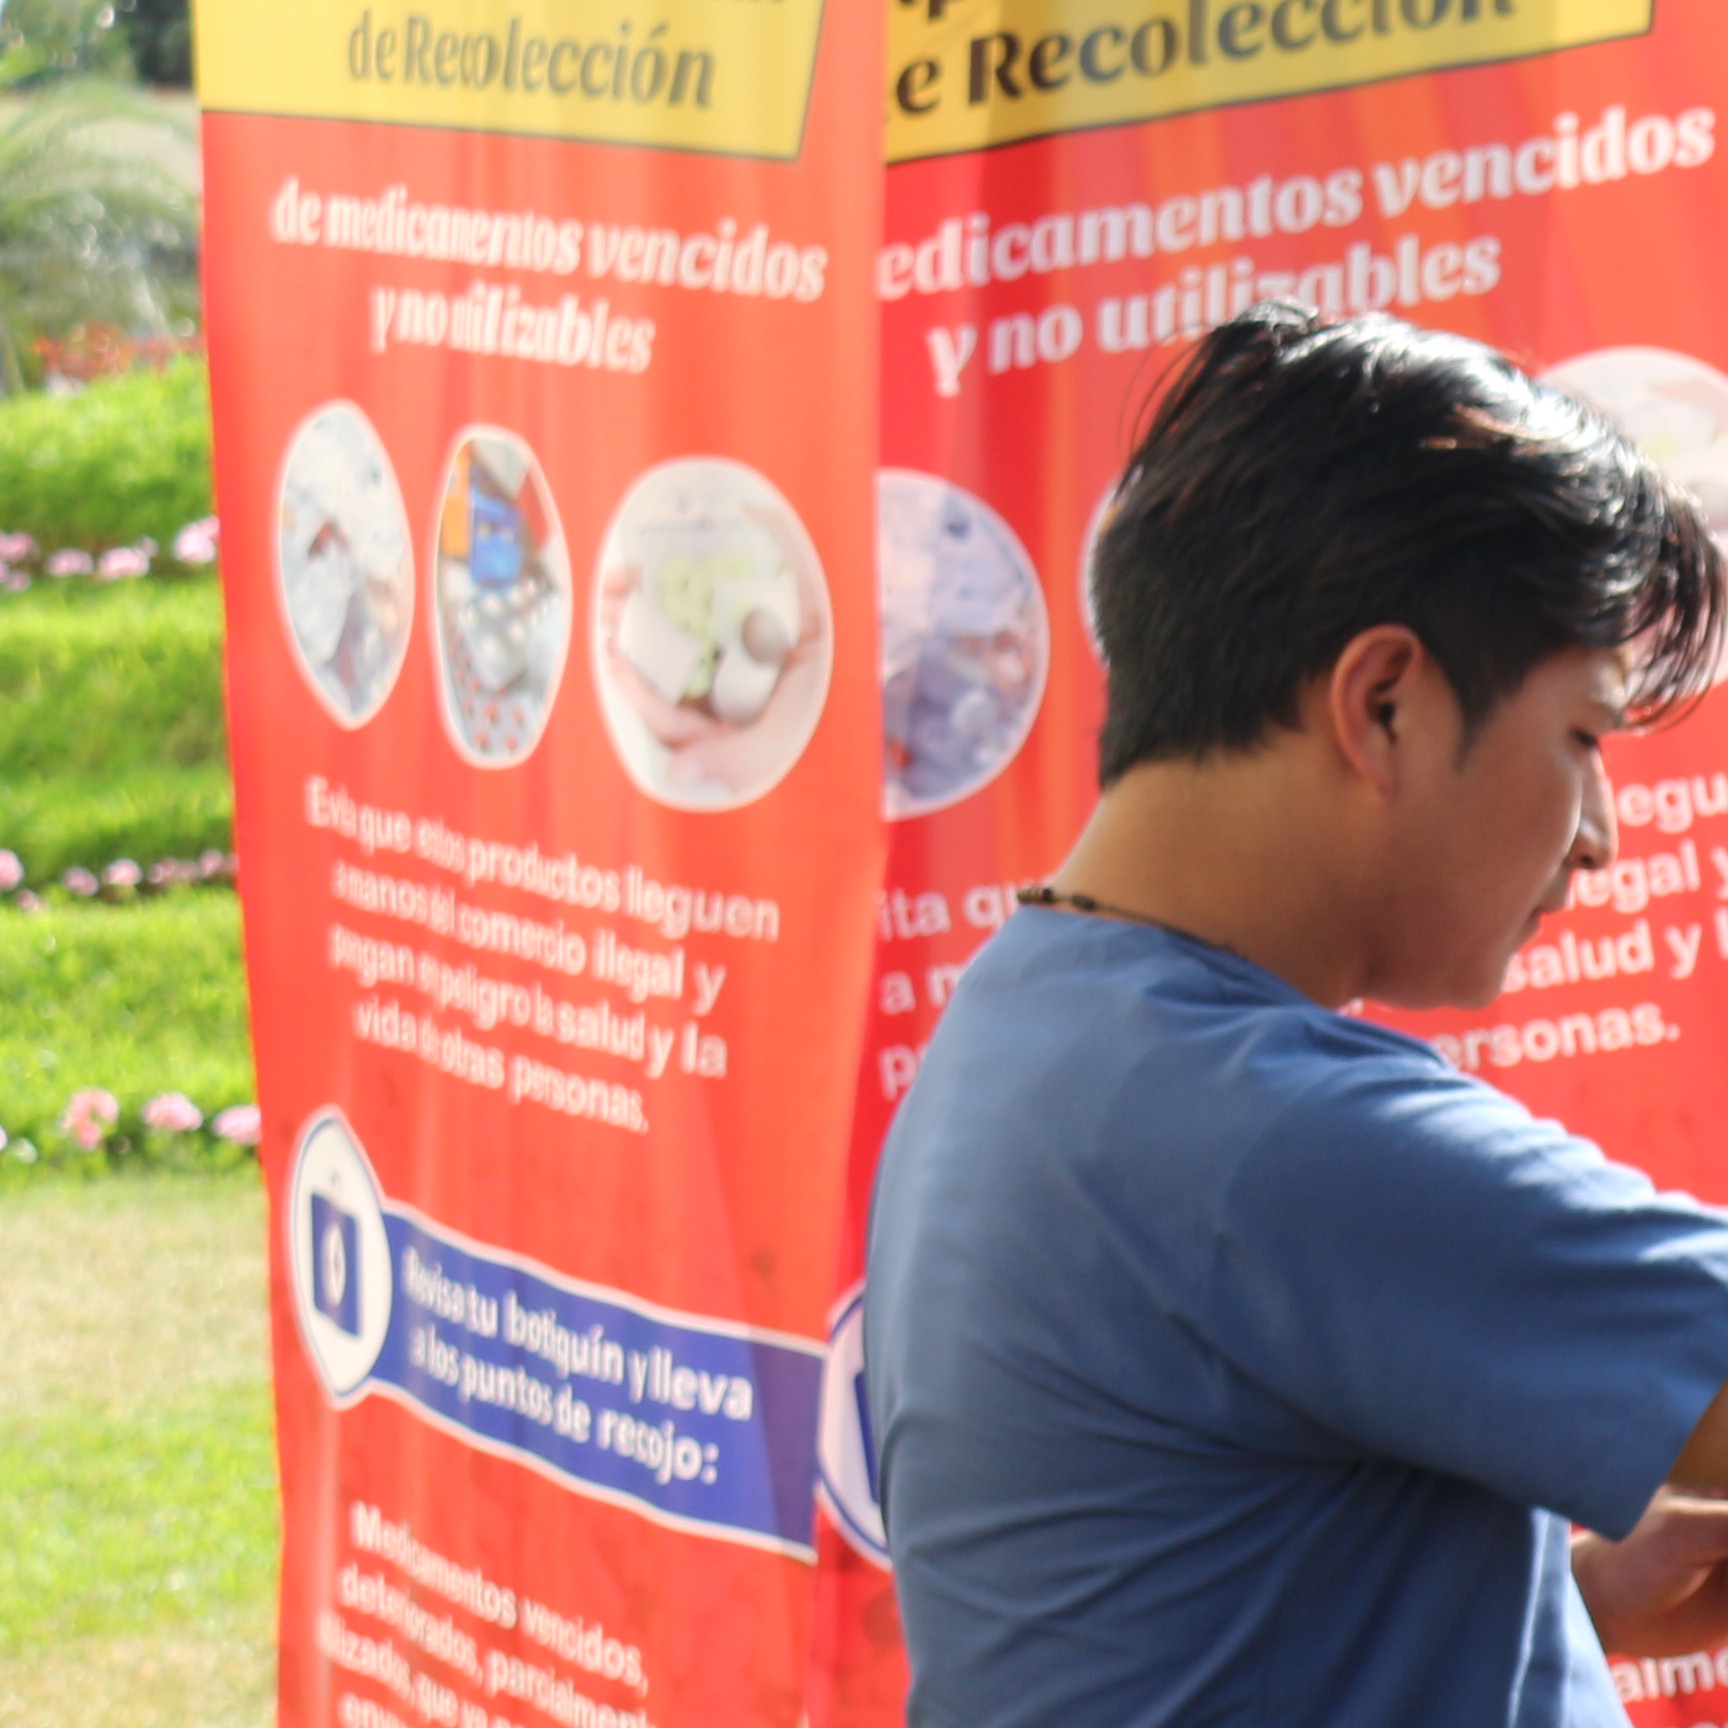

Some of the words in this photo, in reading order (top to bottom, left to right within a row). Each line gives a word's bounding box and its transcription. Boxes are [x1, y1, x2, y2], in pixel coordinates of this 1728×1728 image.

[401, 14, 716, 111] Recolección
[894, 58, 944, 117] e
[271, 176, 320, 244] de
[325, 185, 582, 275] medicamentos
[587, 216, 828, 302] vencidos
[876, 166, 1362, 300] edicamentos
[1373, 102, 1715, 212] vencidos
[372, 283, 397, 353] y
[400, 292, 449, 347] no
[451, 283, 655, 374] utilizables
[925, 322, 978, 398] y
[989, 297, 1083, 378] no
[1095, 232, 1502, 354] utilizables
[360, 808, 412, 855] que
[466, 841, 621, 911] productos
[626, 867, 781, 942] lleguen
[877, 886, 952, 942] ita
[1567, 837, 1701, 915] egal
[458, 906, 587, 975] comercio
[693, 962, 726, 1017] y
[878, 970, 916, 1016] a
[1500, 917, 1656, 993] salud
[1664, 922, 1703, 980] y
[353, 996, 419, 1050] vida
[439, 1024, 506, 1087] otras
[510, 1053, 650, 1134] personas.
[554, 993, 646, 1061] salud
[647, 1024, 676, 1078] y
[680, 1022, 727, 1078] la
[1433, 1002, 1681, 1072] ersonas.
[466, 1291, 498, 1337] tu
[505, 1291, 625, 1385] botiquín
[628, 1349, 650, 1402] y
[651, 1344, 753, 1420] lleva
[428, 1336, 459, 1386] los
[459, 1356, 554, 1424] puntos
[555, 1385, 592, 1443] de
[598, 1404, 720, 1484] recojo:
[352, 1500, 519, 1629] Medicamentos
[521, 1596, 650, 1698] vencidos,
[415, 1673, 459, 1728] que
